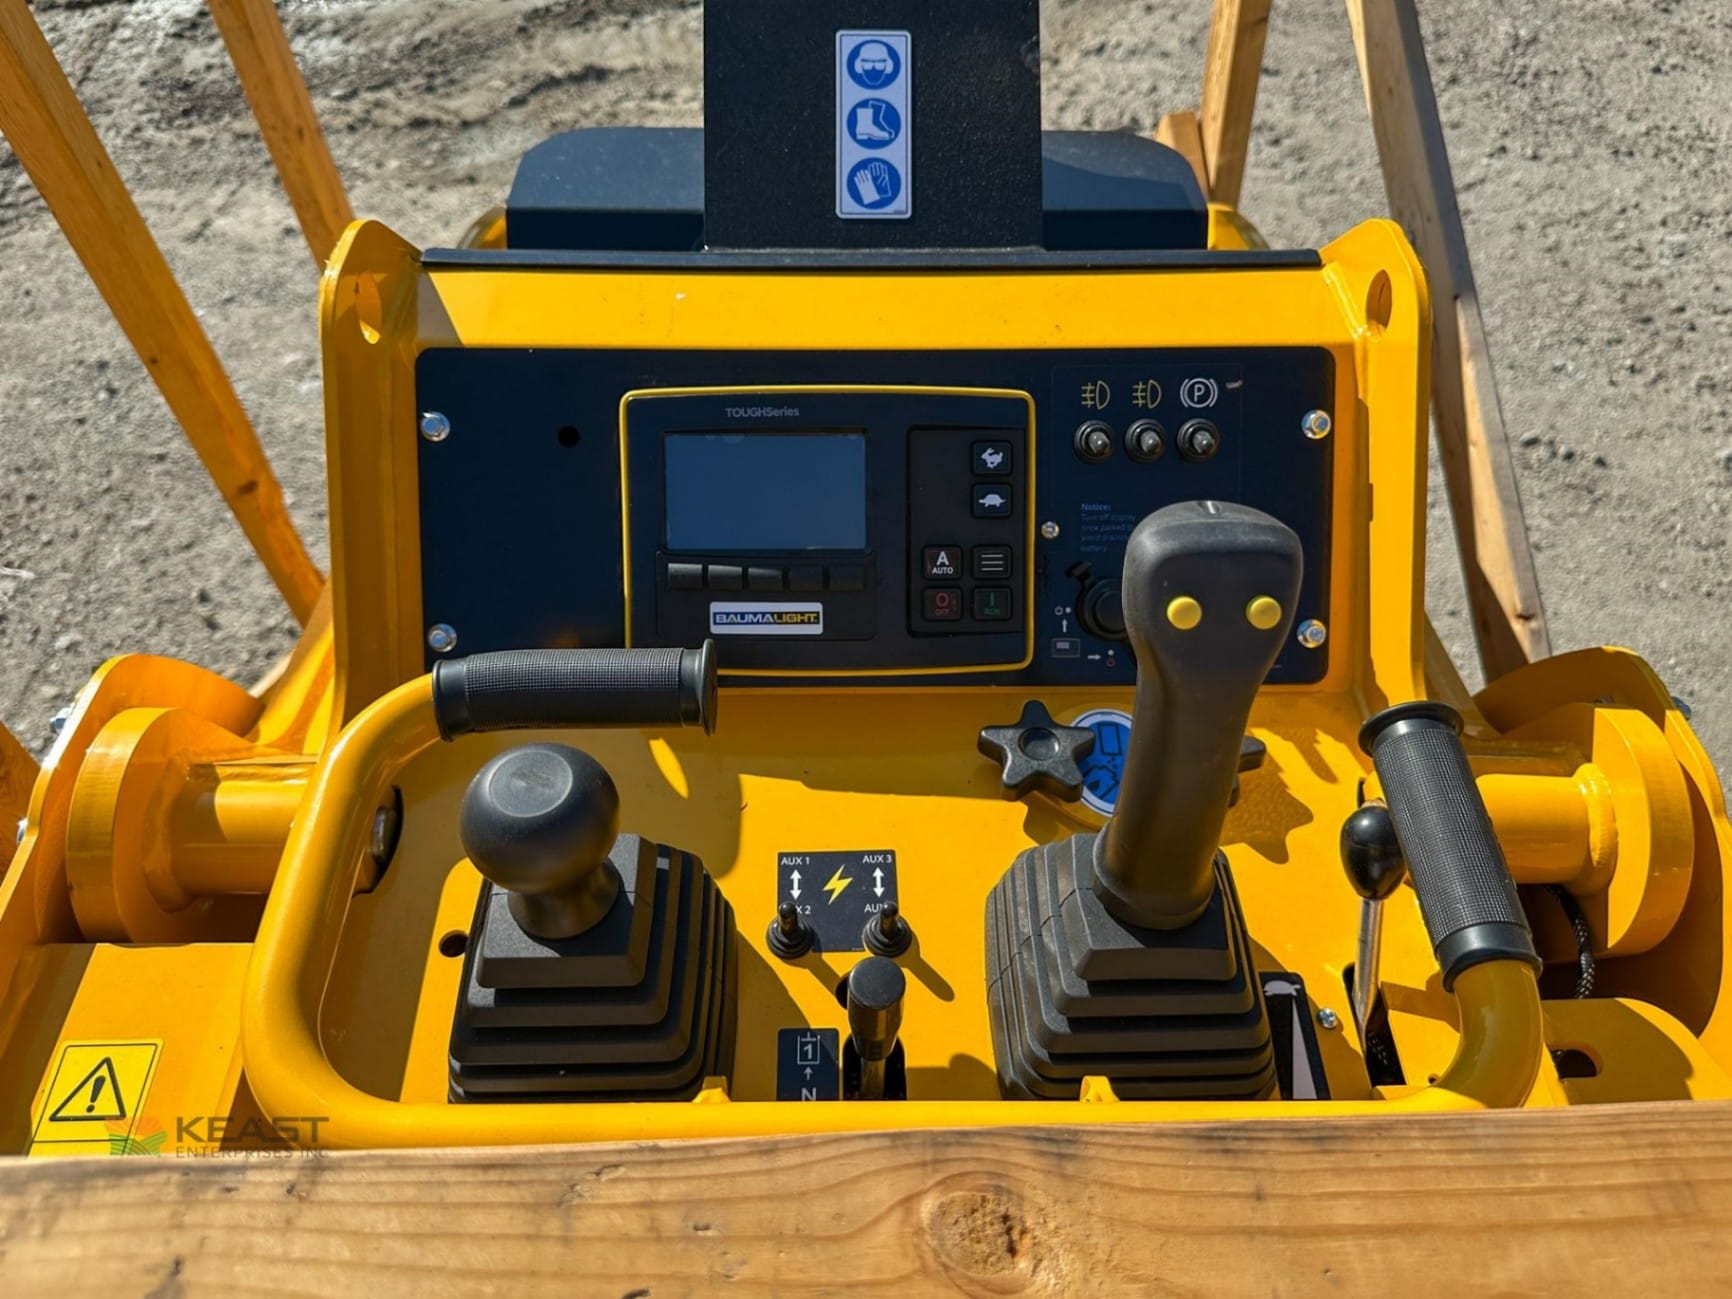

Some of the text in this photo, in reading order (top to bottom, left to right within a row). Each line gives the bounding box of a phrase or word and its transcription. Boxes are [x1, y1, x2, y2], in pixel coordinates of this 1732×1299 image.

[725, 406, 800, 418] TOUGHSeries
[1081, 503, 1111, 511] Notice:
[936, 551, 949, 566] A
[931, 566, 954, 575] AUTO
[715, 613, 818, 624] BAUMALIGHT
[781, 856, 810, 866] AUX 1
[862, 854, 893, 864] AUX 3
[803, 1043, 813, 1060] 1
[801, 1087, 817, 1102] N
